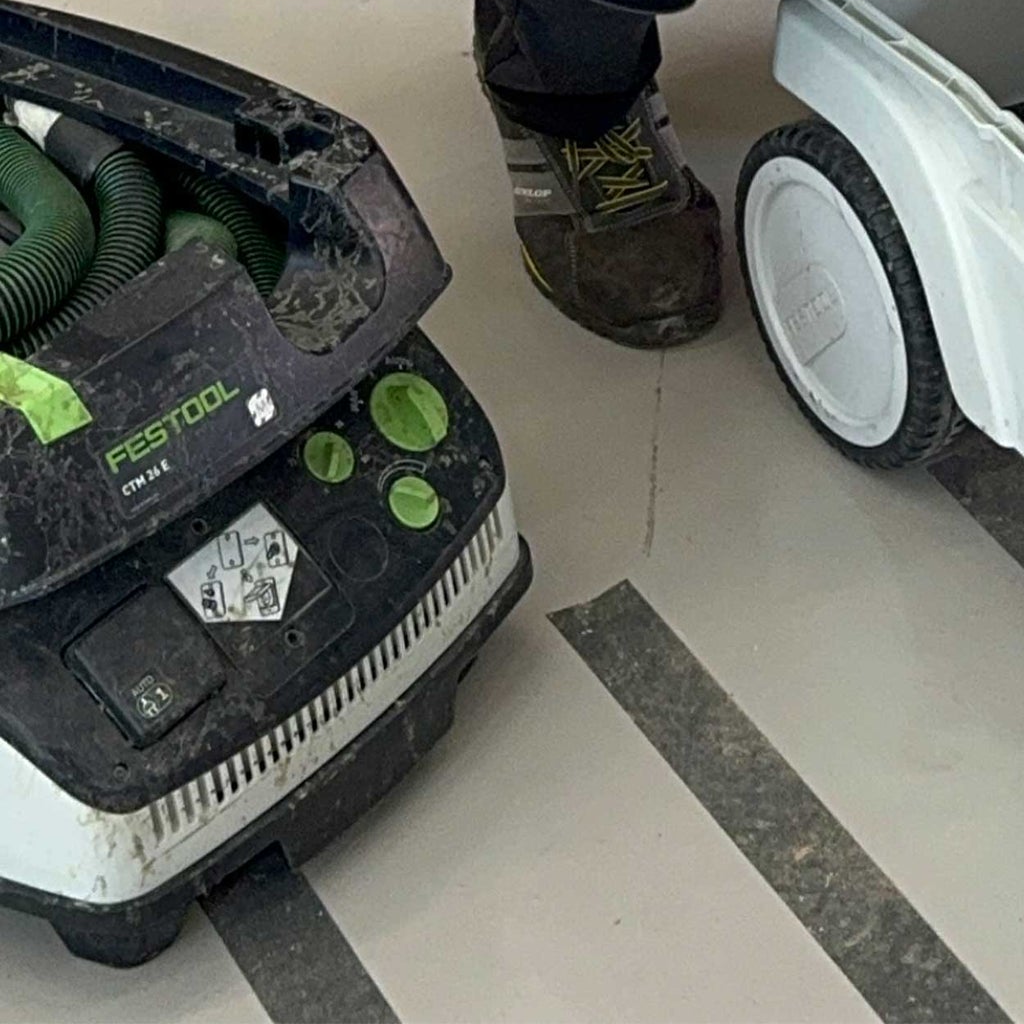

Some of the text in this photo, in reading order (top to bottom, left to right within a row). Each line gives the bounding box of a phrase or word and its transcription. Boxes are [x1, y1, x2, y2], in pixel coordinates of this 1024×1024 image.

[105, 380, 240, 473] FESTOOL
[121, 458, 171, 497] CTM 26 E
[131, 674, 155, 697] AUTO
